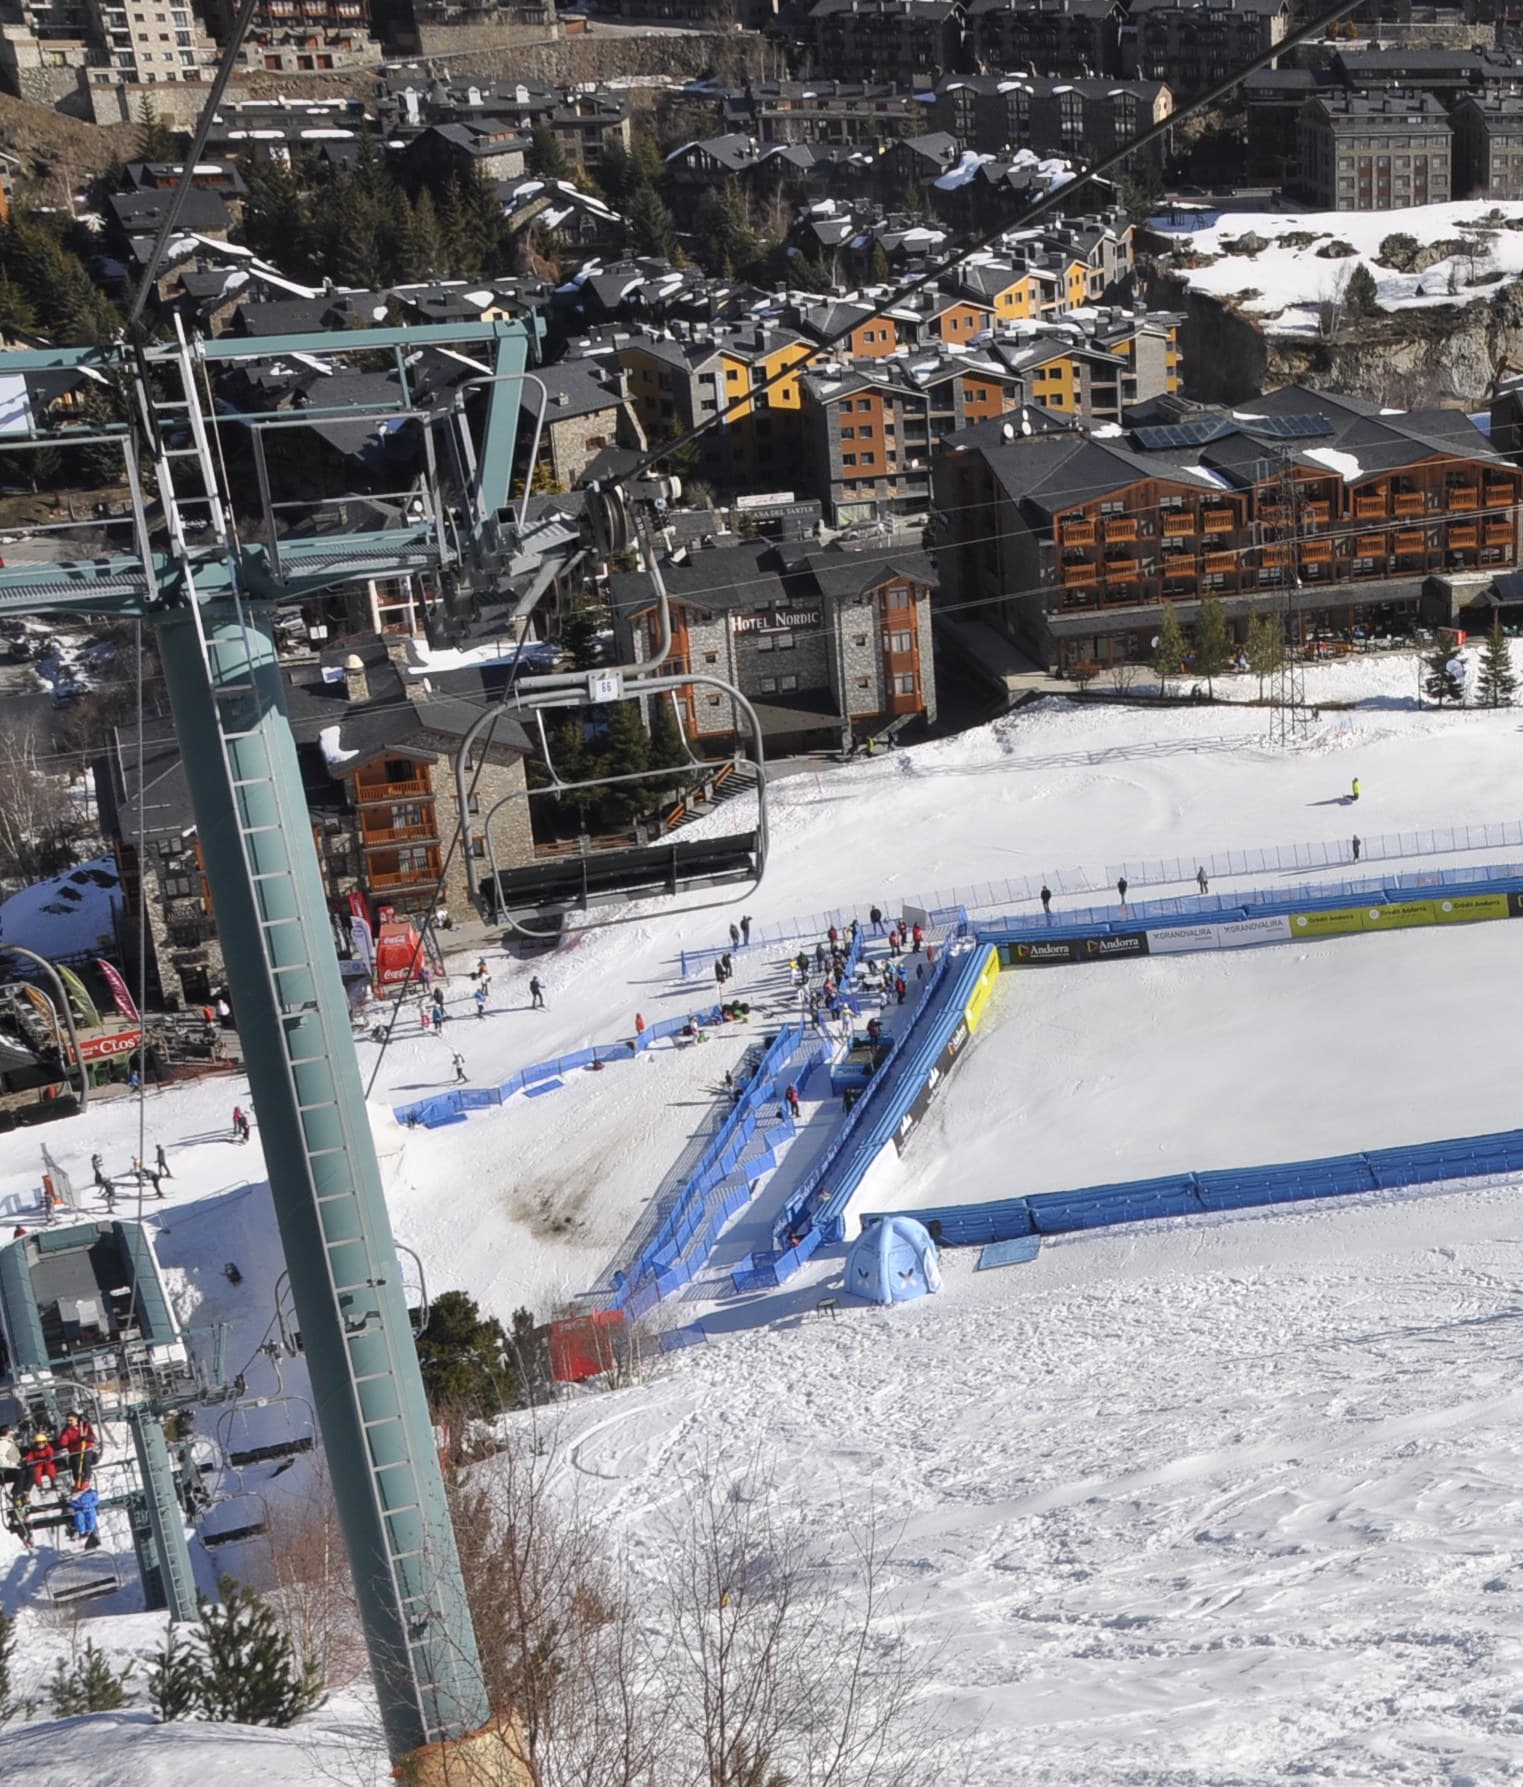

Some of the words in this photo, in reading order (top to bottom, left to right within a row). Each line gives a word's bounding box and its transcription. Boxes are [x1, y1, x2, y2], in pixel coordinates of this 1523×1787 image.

[732, 615, 770, 631] HOTEL
[775, 612, 819, 627] NORDIC
[1230, 919, 1283, 933] GRANDVALIRA
[1159, 928, 1212, 940] GRANDVALIRA
[1030, 944, 1069, 955] Andorra
[1099, 937, 1138, 950] Andorra
[100, 1038, 136, 1054] CLOS
